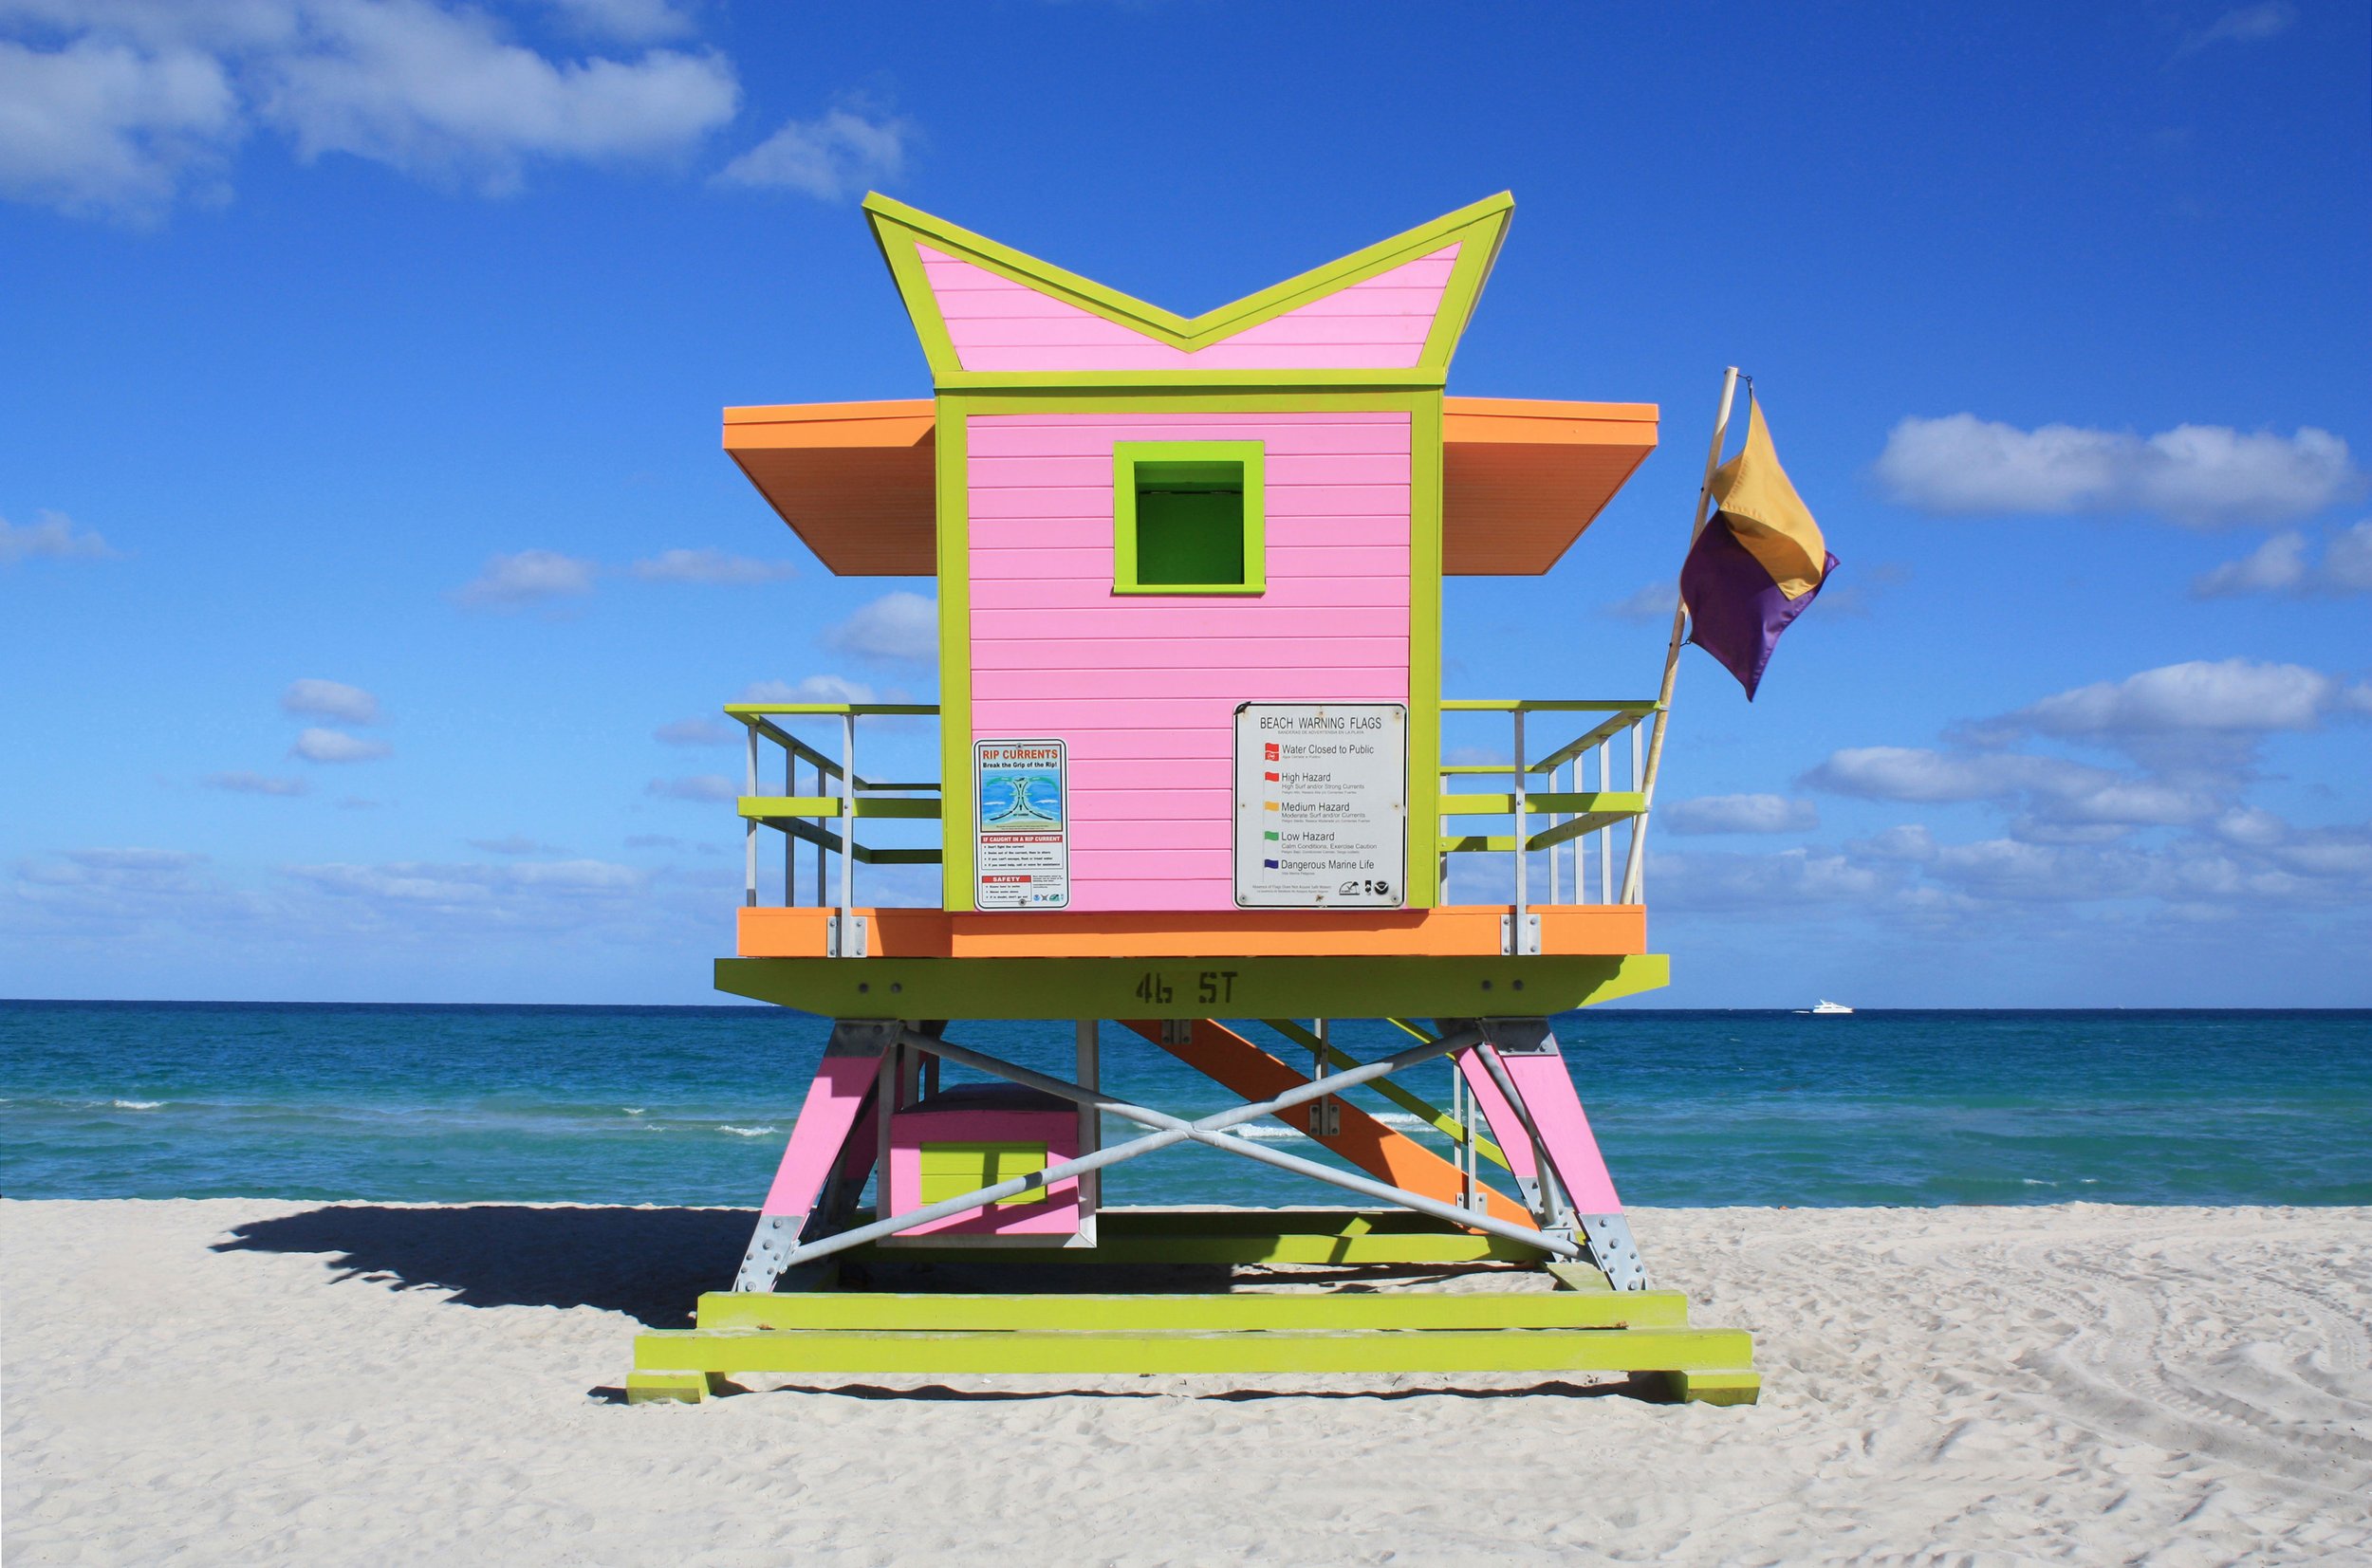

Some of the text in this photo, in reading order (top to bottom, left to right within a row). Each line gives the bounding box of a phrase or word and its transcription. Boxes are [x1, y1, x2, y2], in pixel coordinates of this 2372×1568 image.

[1260, 716, 1381, 729] BEACH WARNING FLAGS
[982, 749, 1058, 759] RIP CURRENTS
[1282, 744, 1374, 753] Water Closed to Public
[1282, 772, 1330, 784] High Hazard
[1281, 802, 1350, 811] Medium Hazard
[1281, 832, 1335, 840] Low Hazard
[1281, 859, 1374, 871] Dangerous Marine Life
[1198, 971, 1238, 1004] ST
